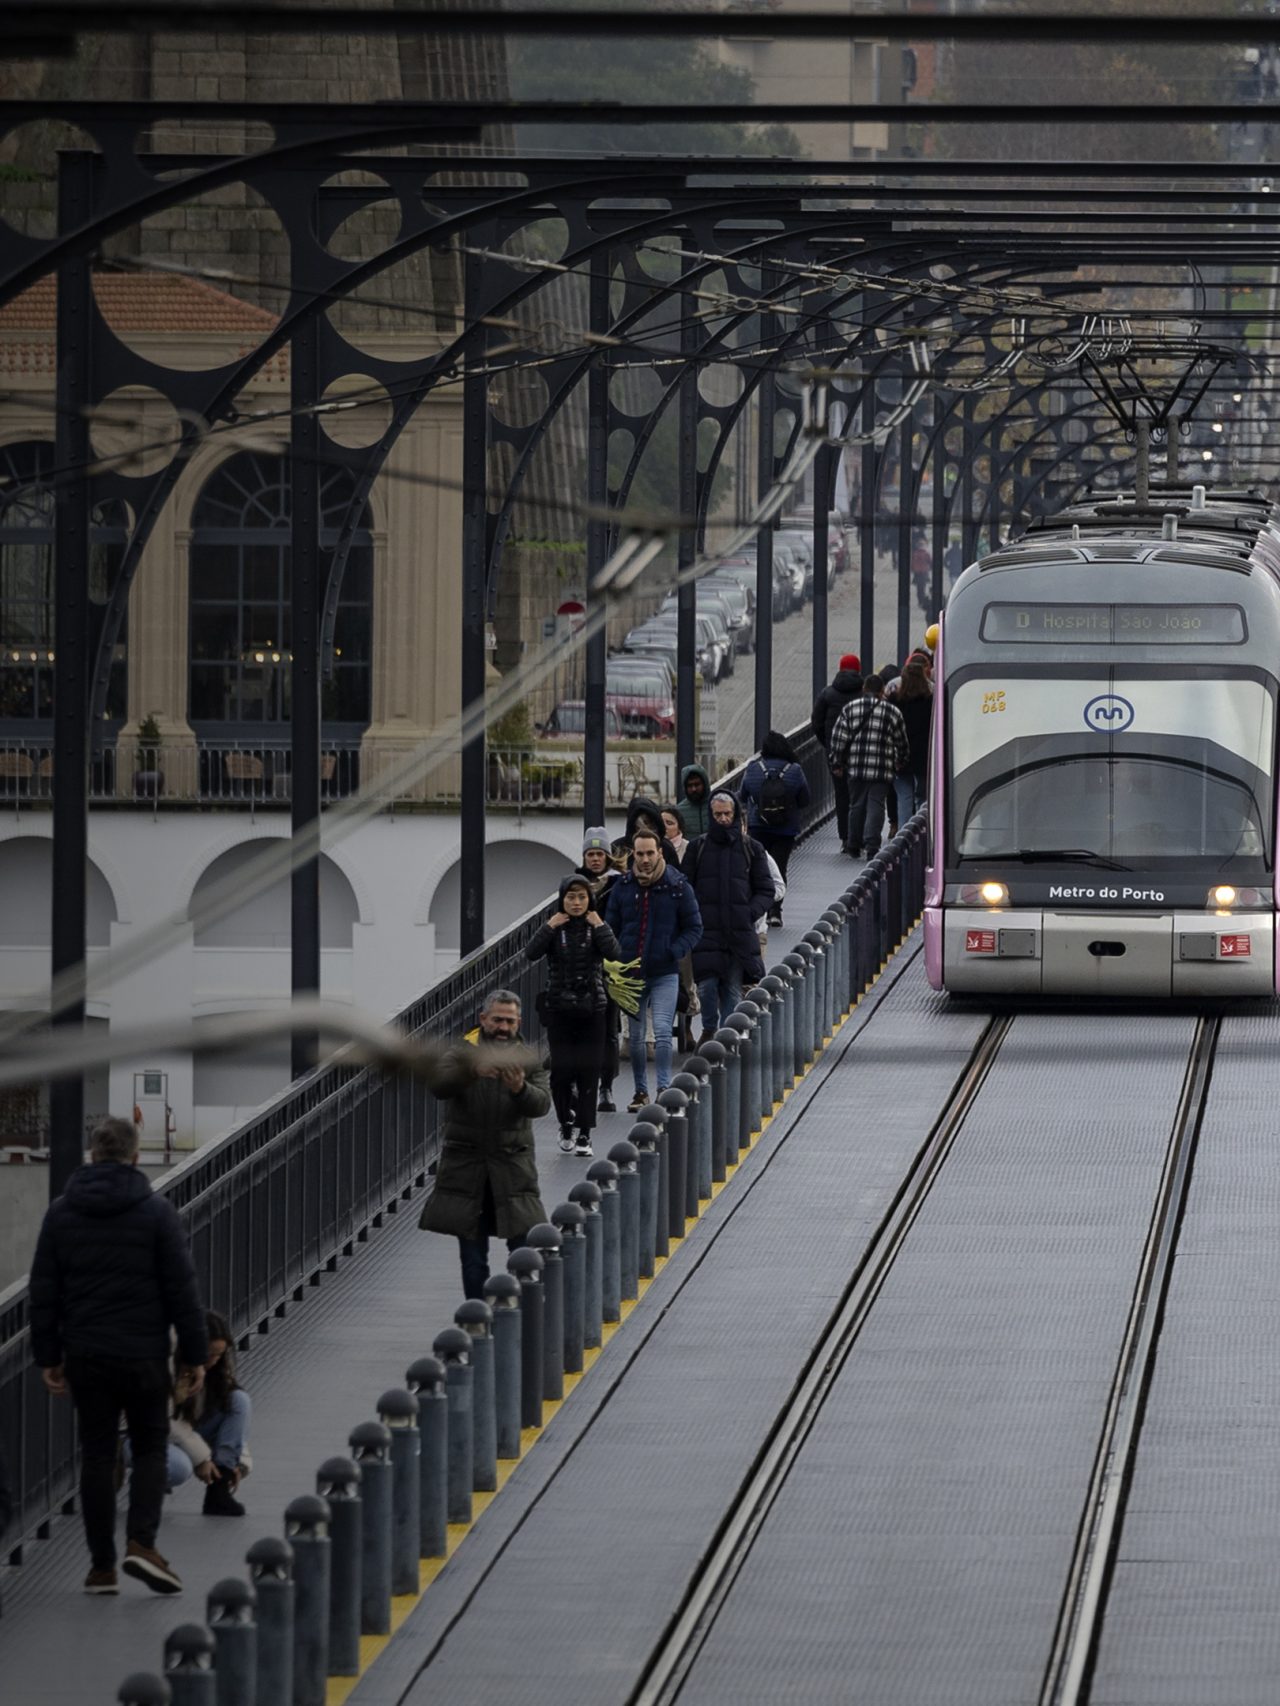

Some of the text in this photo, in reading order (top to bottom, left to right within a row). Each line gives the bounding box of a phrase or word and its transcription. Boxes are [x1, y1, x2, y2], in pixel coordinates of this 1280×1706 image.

[1016, 612, 1030, 629] D
[1049, 886, 1165, 901] Metro do Porto
